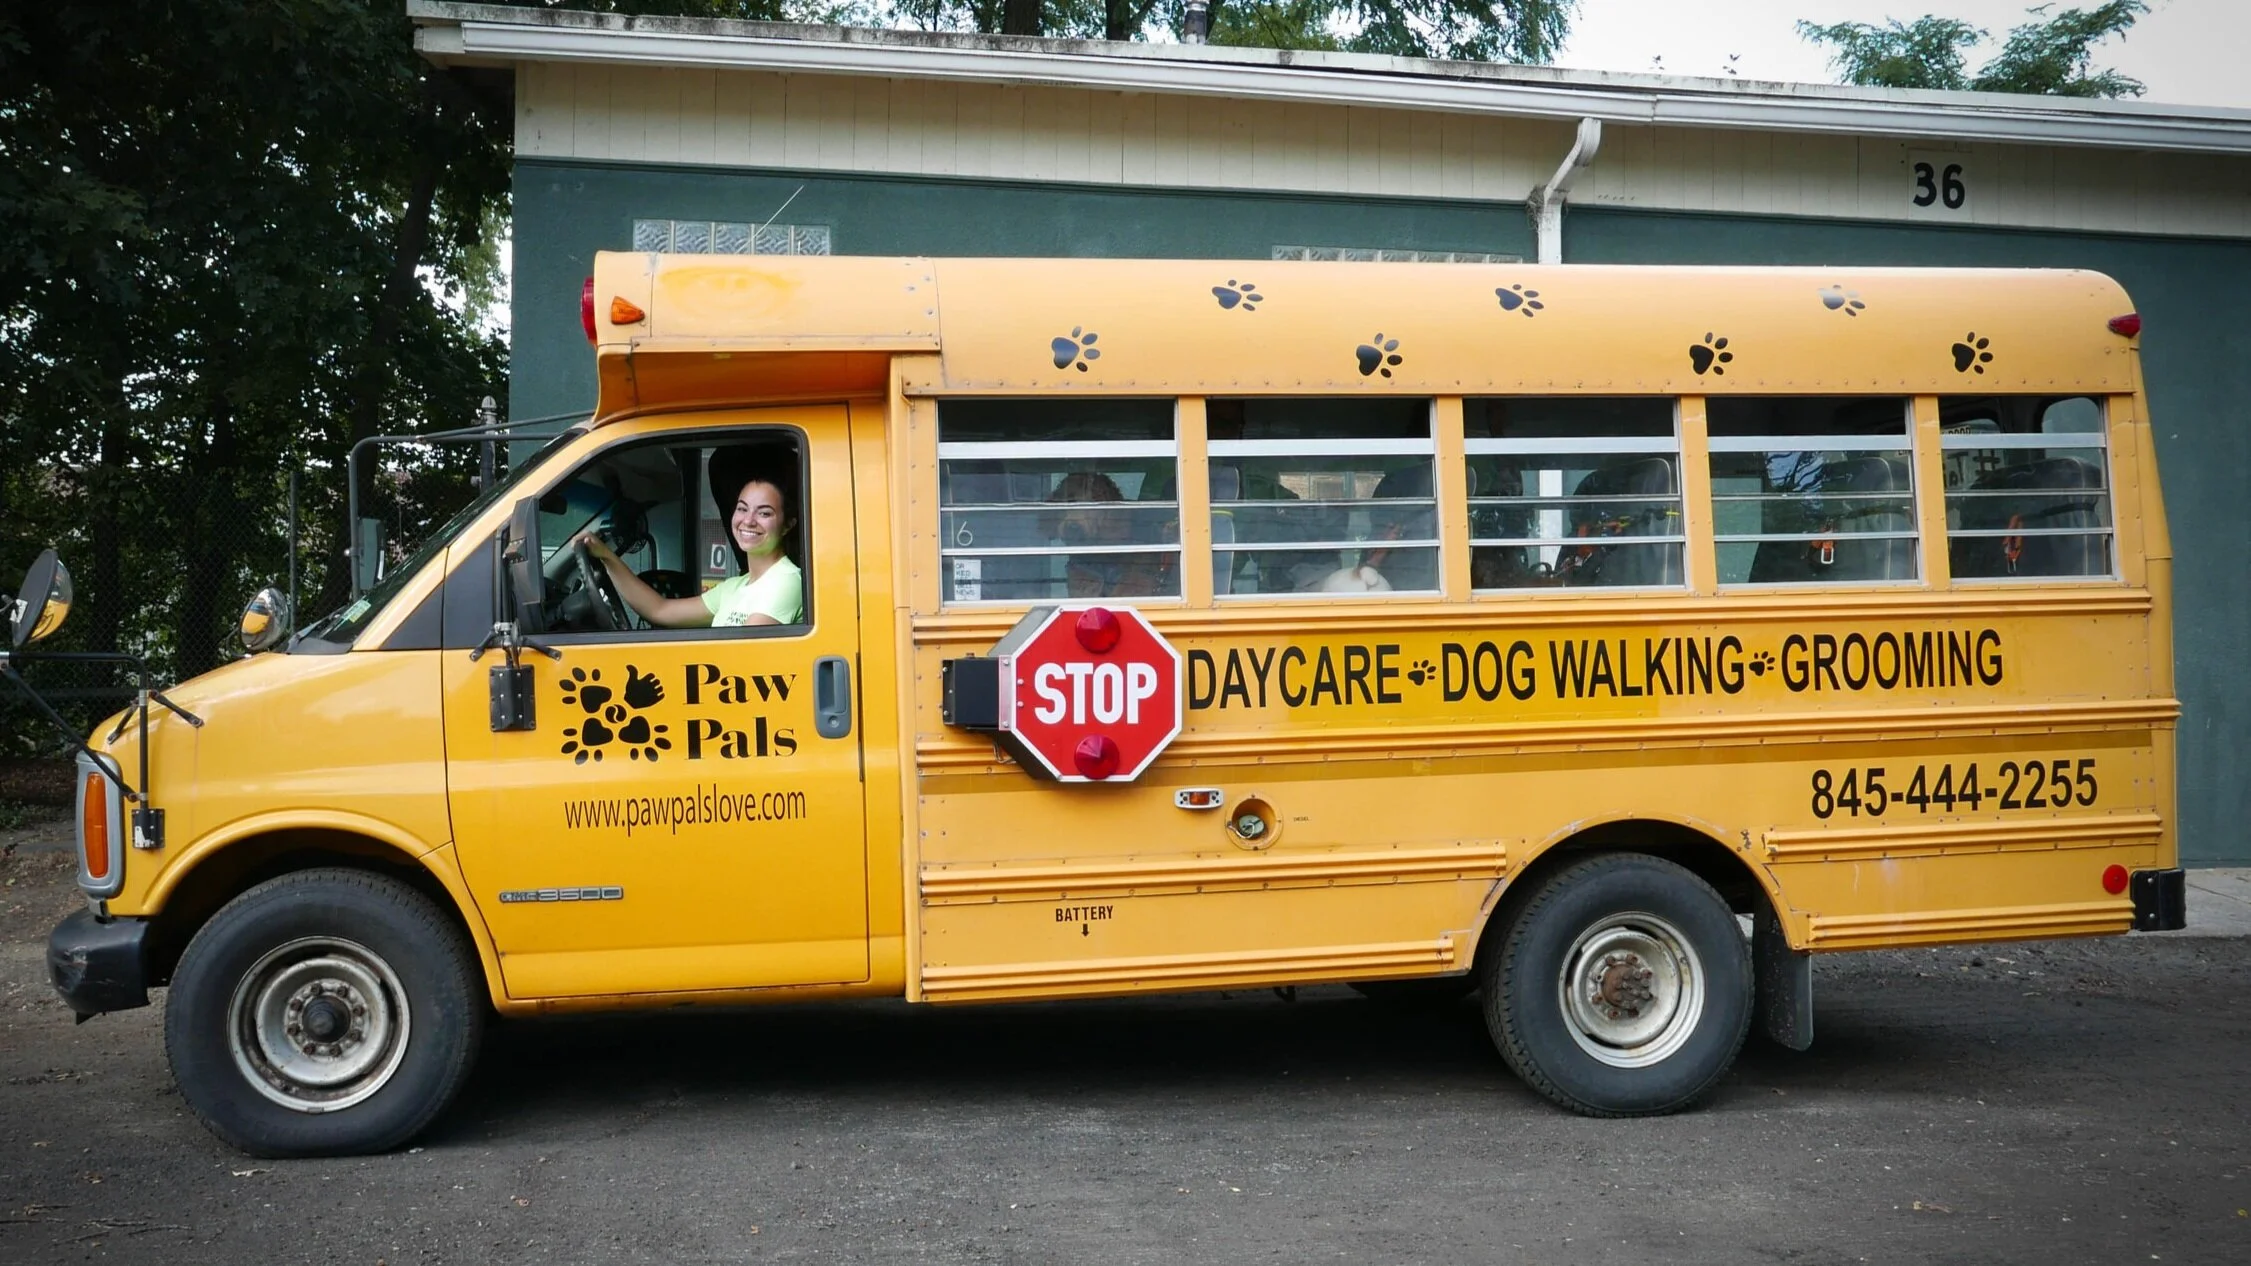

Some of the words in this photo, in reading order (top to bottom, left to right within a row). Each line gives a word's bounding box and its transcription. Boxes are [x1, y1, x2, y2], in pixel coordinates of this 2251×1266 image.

[1912, 161, 1965, 209] 36
[957, 521, 973, 546] 6
[683, 663, 797, 705] Paw
[1034, 662, 1158, 724] STOP
[1188, 645, 1402, 710] DAYCARE
[1442, 641, 1536, 702] DOG
[1550, 635, 1745, 699] WALKING
[1781, 630, 2003, 692] GROOMING
[684, 716, 798, 760] Pals
[564, 783, 807, 838] www.pawpalslove.com
[1811, 758, 2098, 819] 845-444-2255
[1055, 905, 1114, 922] BATTERY
